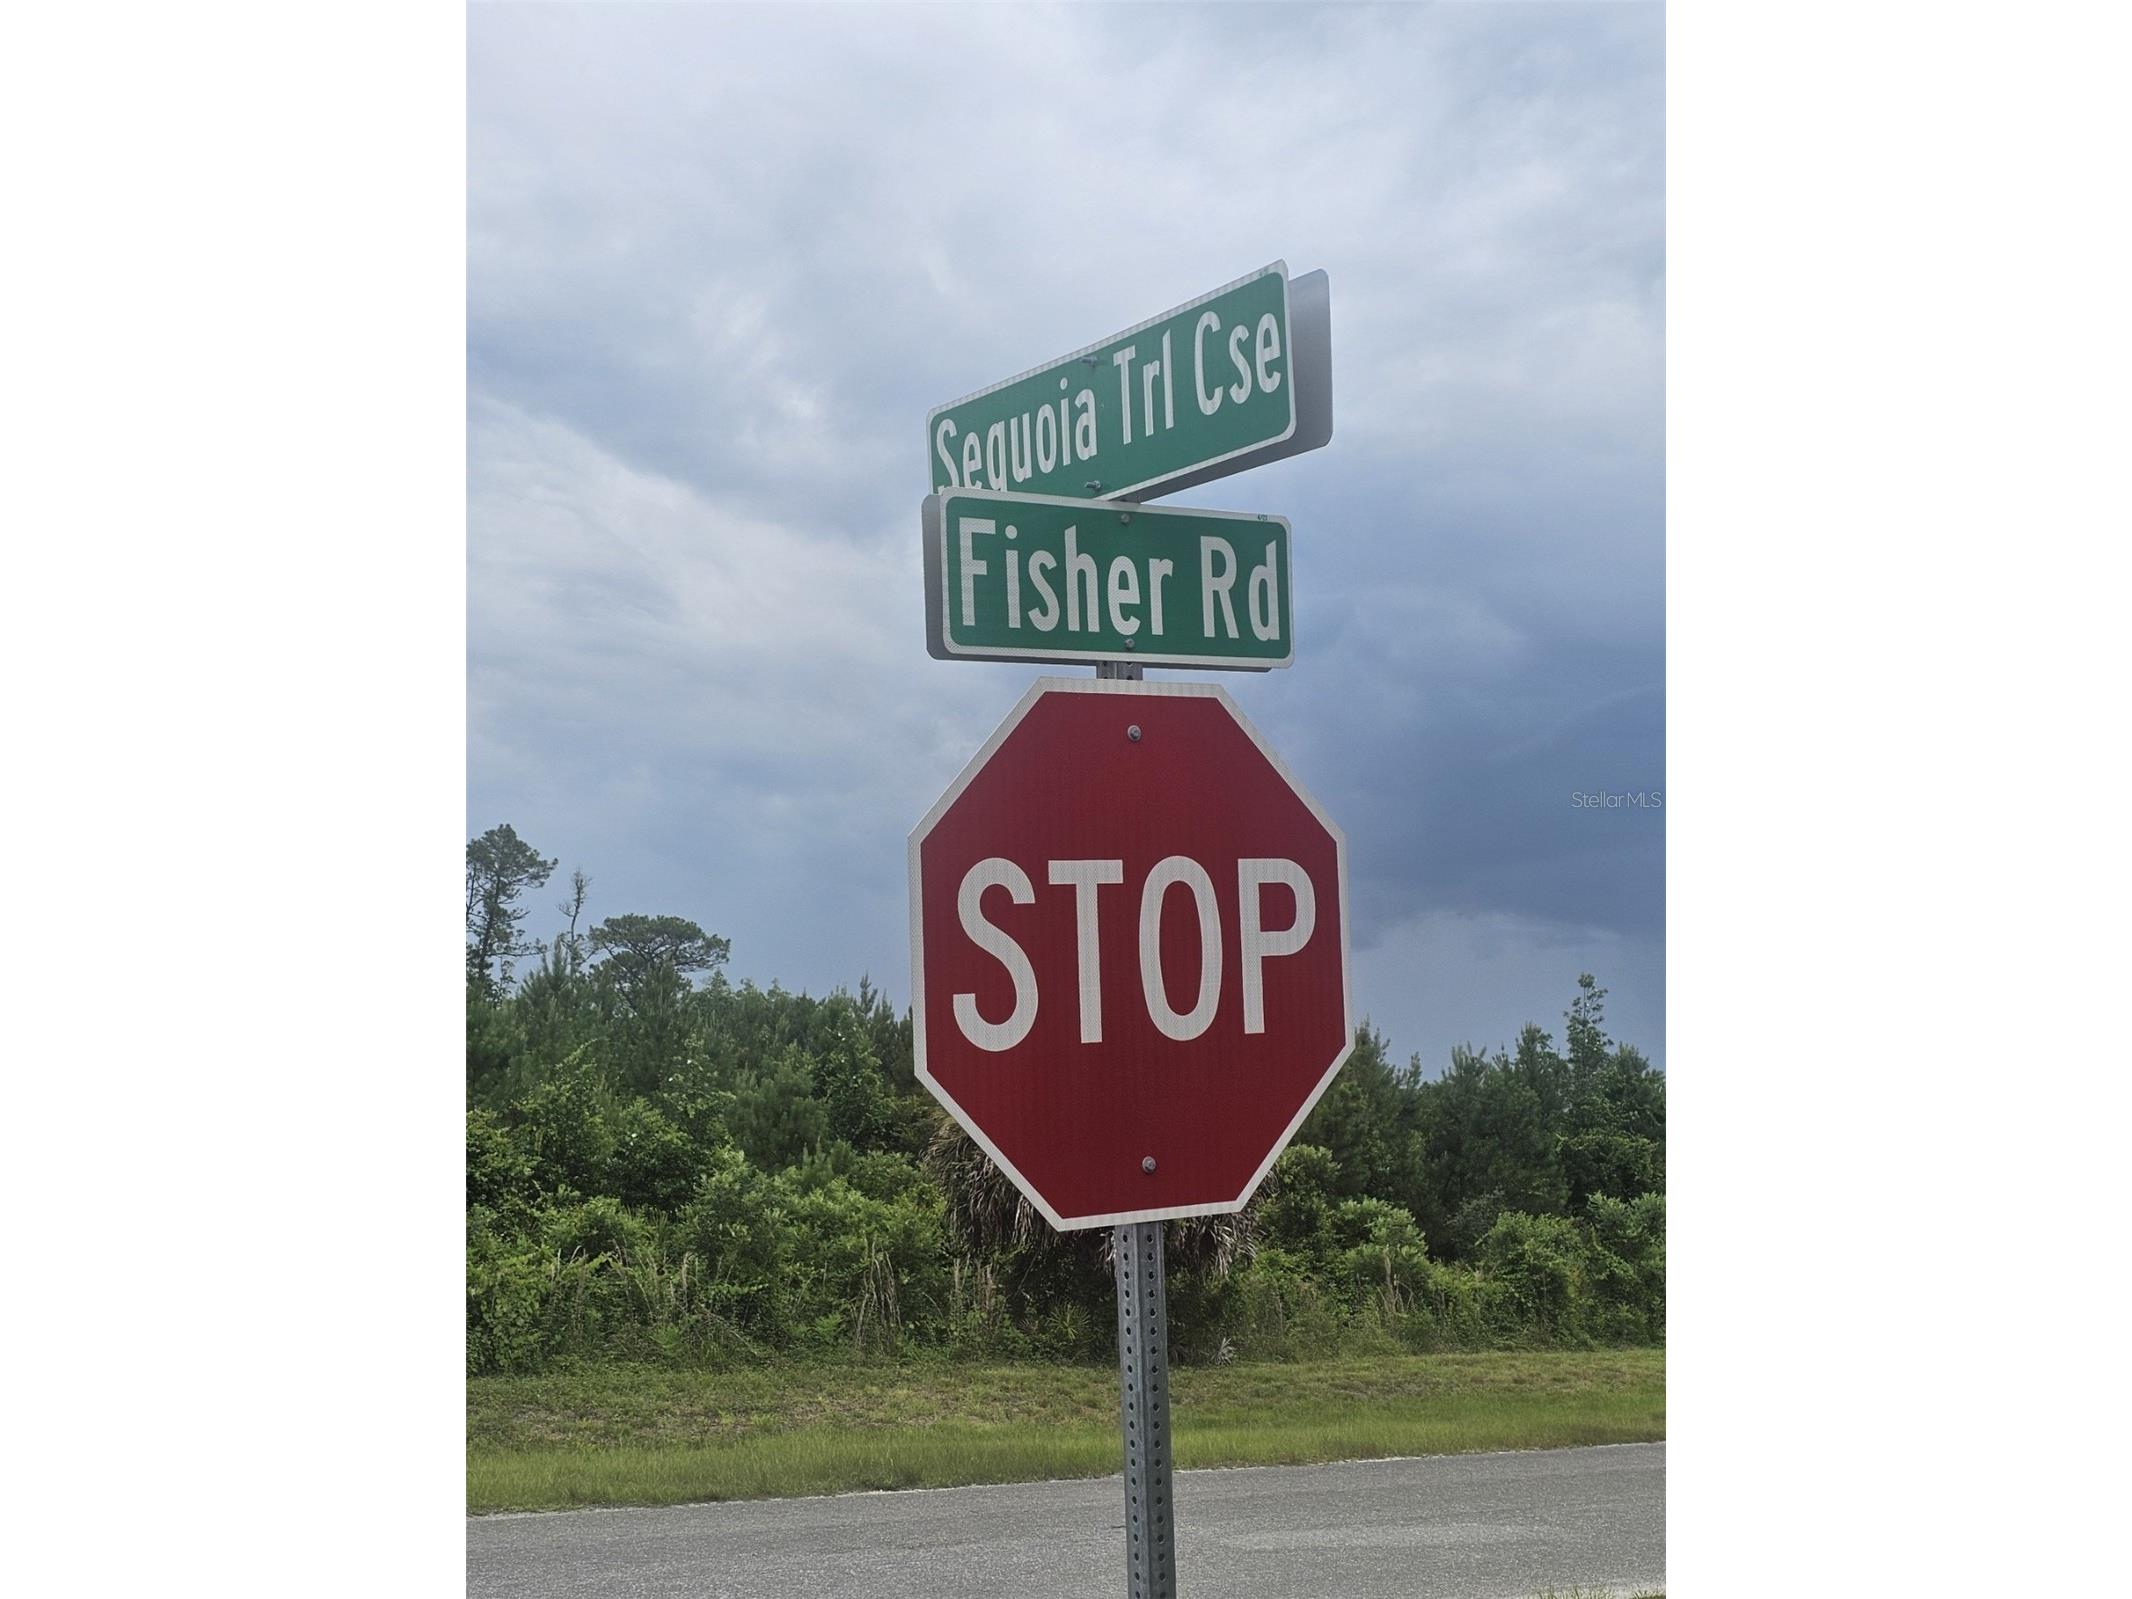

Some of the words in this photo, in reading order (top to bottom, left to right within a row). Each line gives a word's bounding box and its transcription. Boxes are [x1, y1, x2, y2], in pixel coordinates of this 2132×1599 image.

[936, 377, 1098, 493] Sequoia
[1113, 328, 1174, 445] Trl
[1194, 311, 1281, 416] Cse
[958, 517, 1174, 636] Fisher
[1200, 535, 1280, 641] Rd
[953, 855, 1317, 1052] STOP
